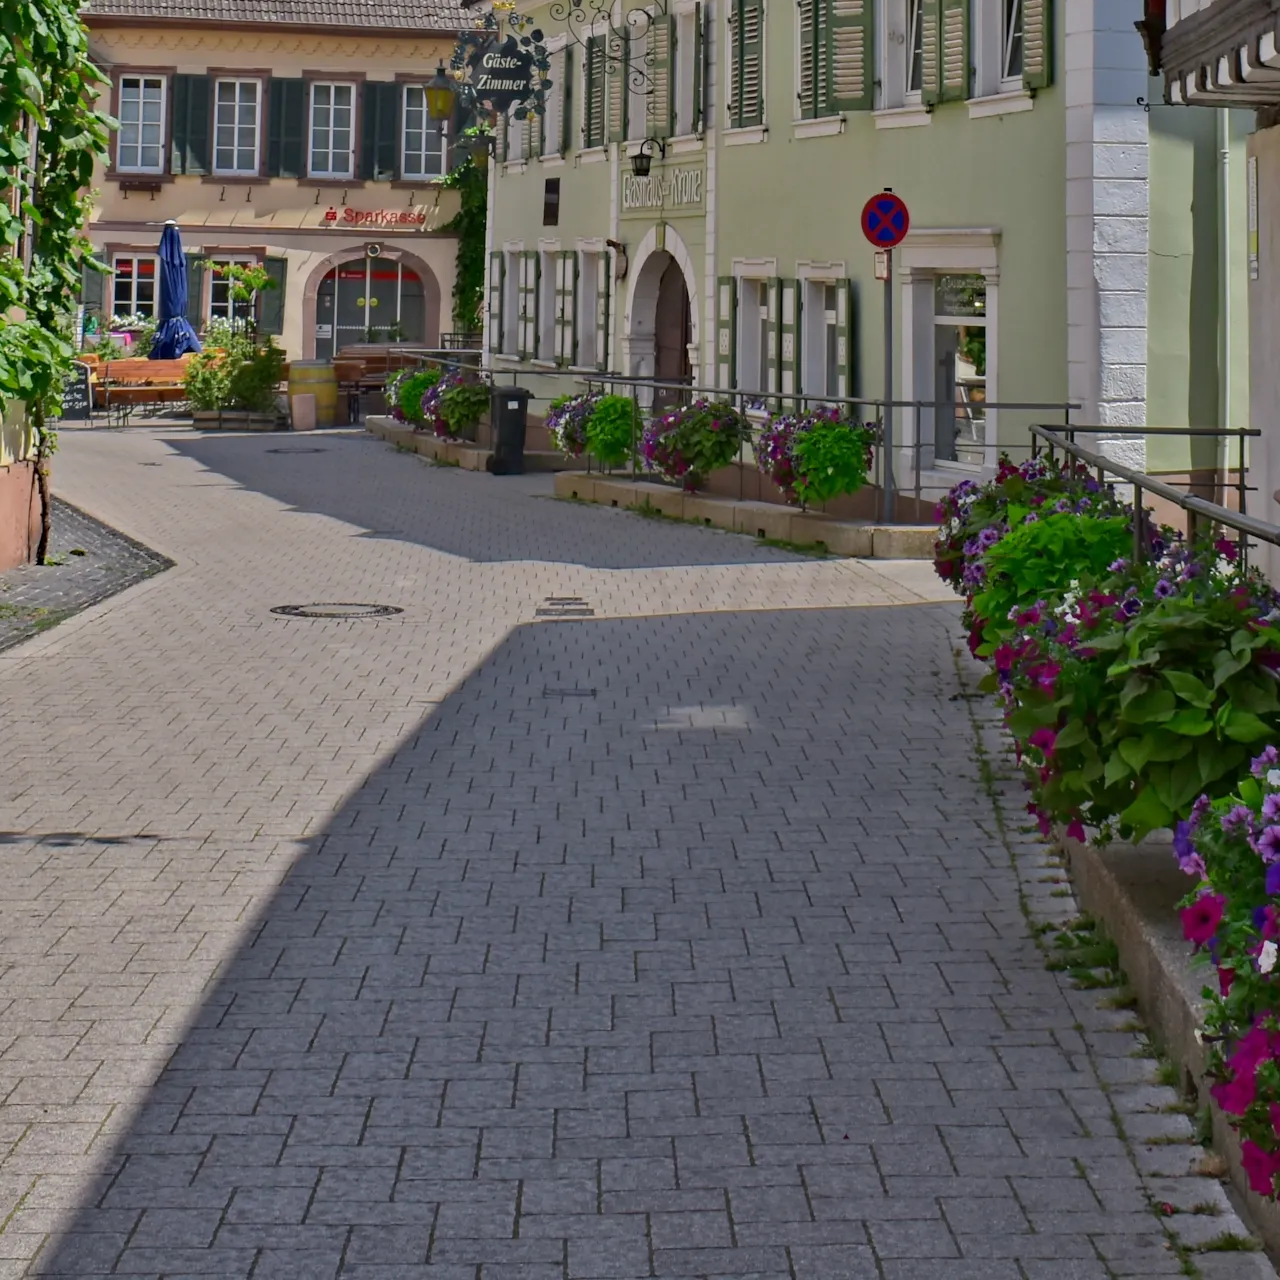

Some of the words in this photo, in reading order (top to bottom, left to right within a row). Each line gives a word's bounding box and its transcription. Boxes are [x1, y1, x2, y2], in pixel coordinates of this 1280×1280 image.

[482, 52, 523, 69] Gäste-
[476, 74, 527, 91] Zimmer
[672, 168, 702, 207] Krone
[343, 207, 427, 226] Sparkasse
